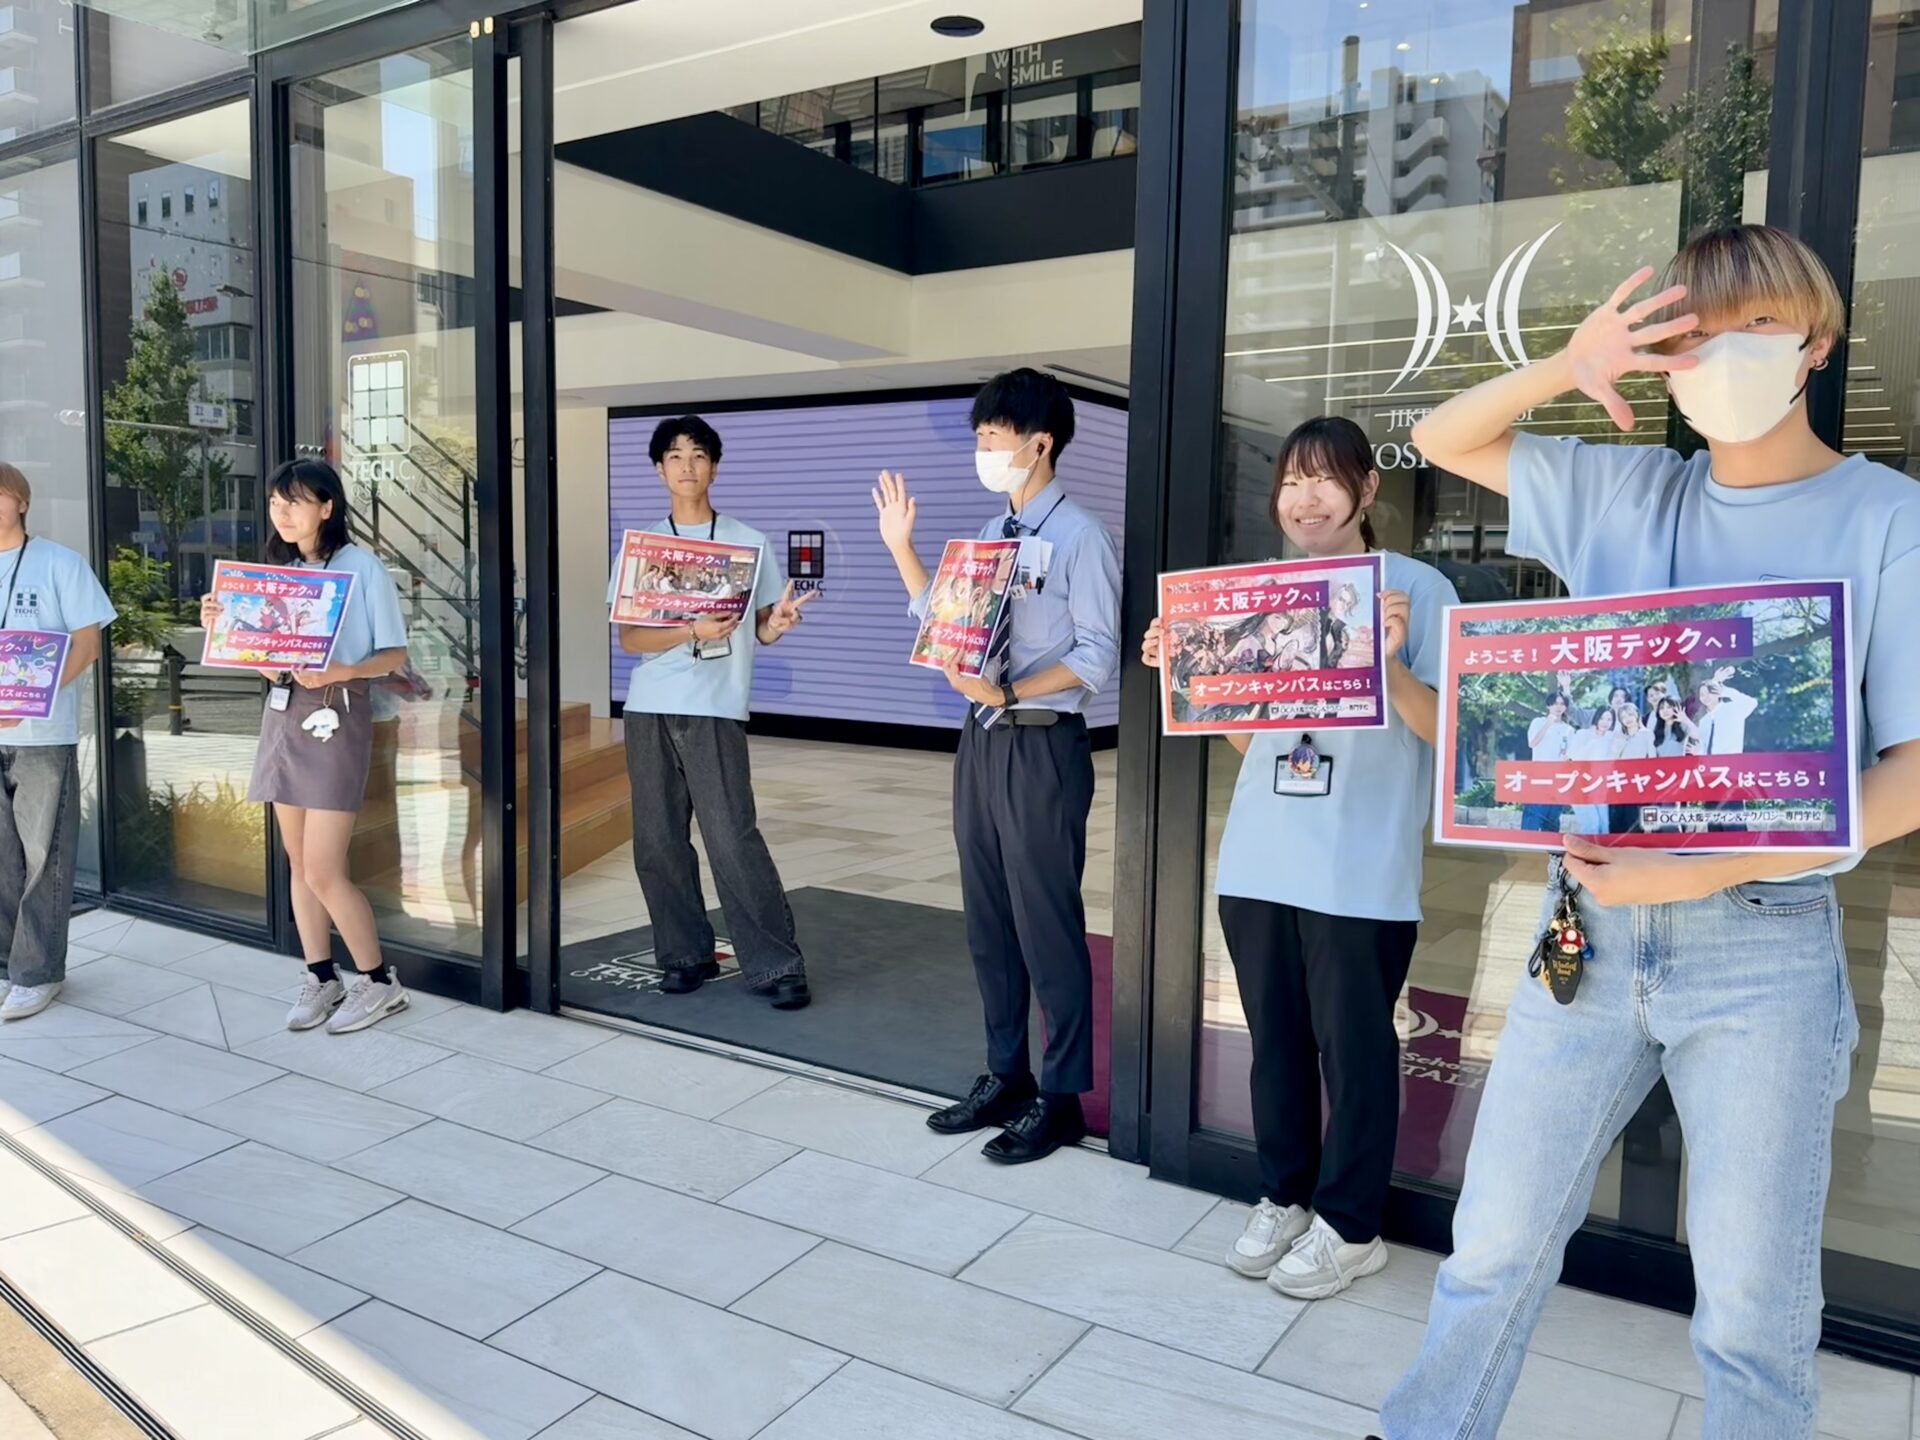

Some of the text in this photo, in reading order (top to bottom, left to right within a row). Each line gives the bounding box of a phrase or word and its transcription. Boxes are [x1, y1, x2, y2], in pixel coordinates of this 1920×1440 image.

[991, 43, 1042, 70] WITH
[1011, 58, 1064, 87] SMILE
[350, 459, 416, 482] TECH.C.
[661, 549, 726, 566] 大阪テックへ！
[253, 580, 319, 597] 大阪テックへ！
[1169, 587, 1321, 615] ようこそ！ 大阪テックへ！
[0, 642, 28, 653] クへ！
[229, 634, 328, 650] オープンキャンパスはこちら！
[1464, 627, 1737, 666] ようこそ！ 大阪テックへ！
[1194, 677, 1371, 698] オープンキャンパスはこちら！
[1503, 765, 1826, 794] オープンキャンパスはこちら！
[1402, 1064, 1485, 1089] TALI
